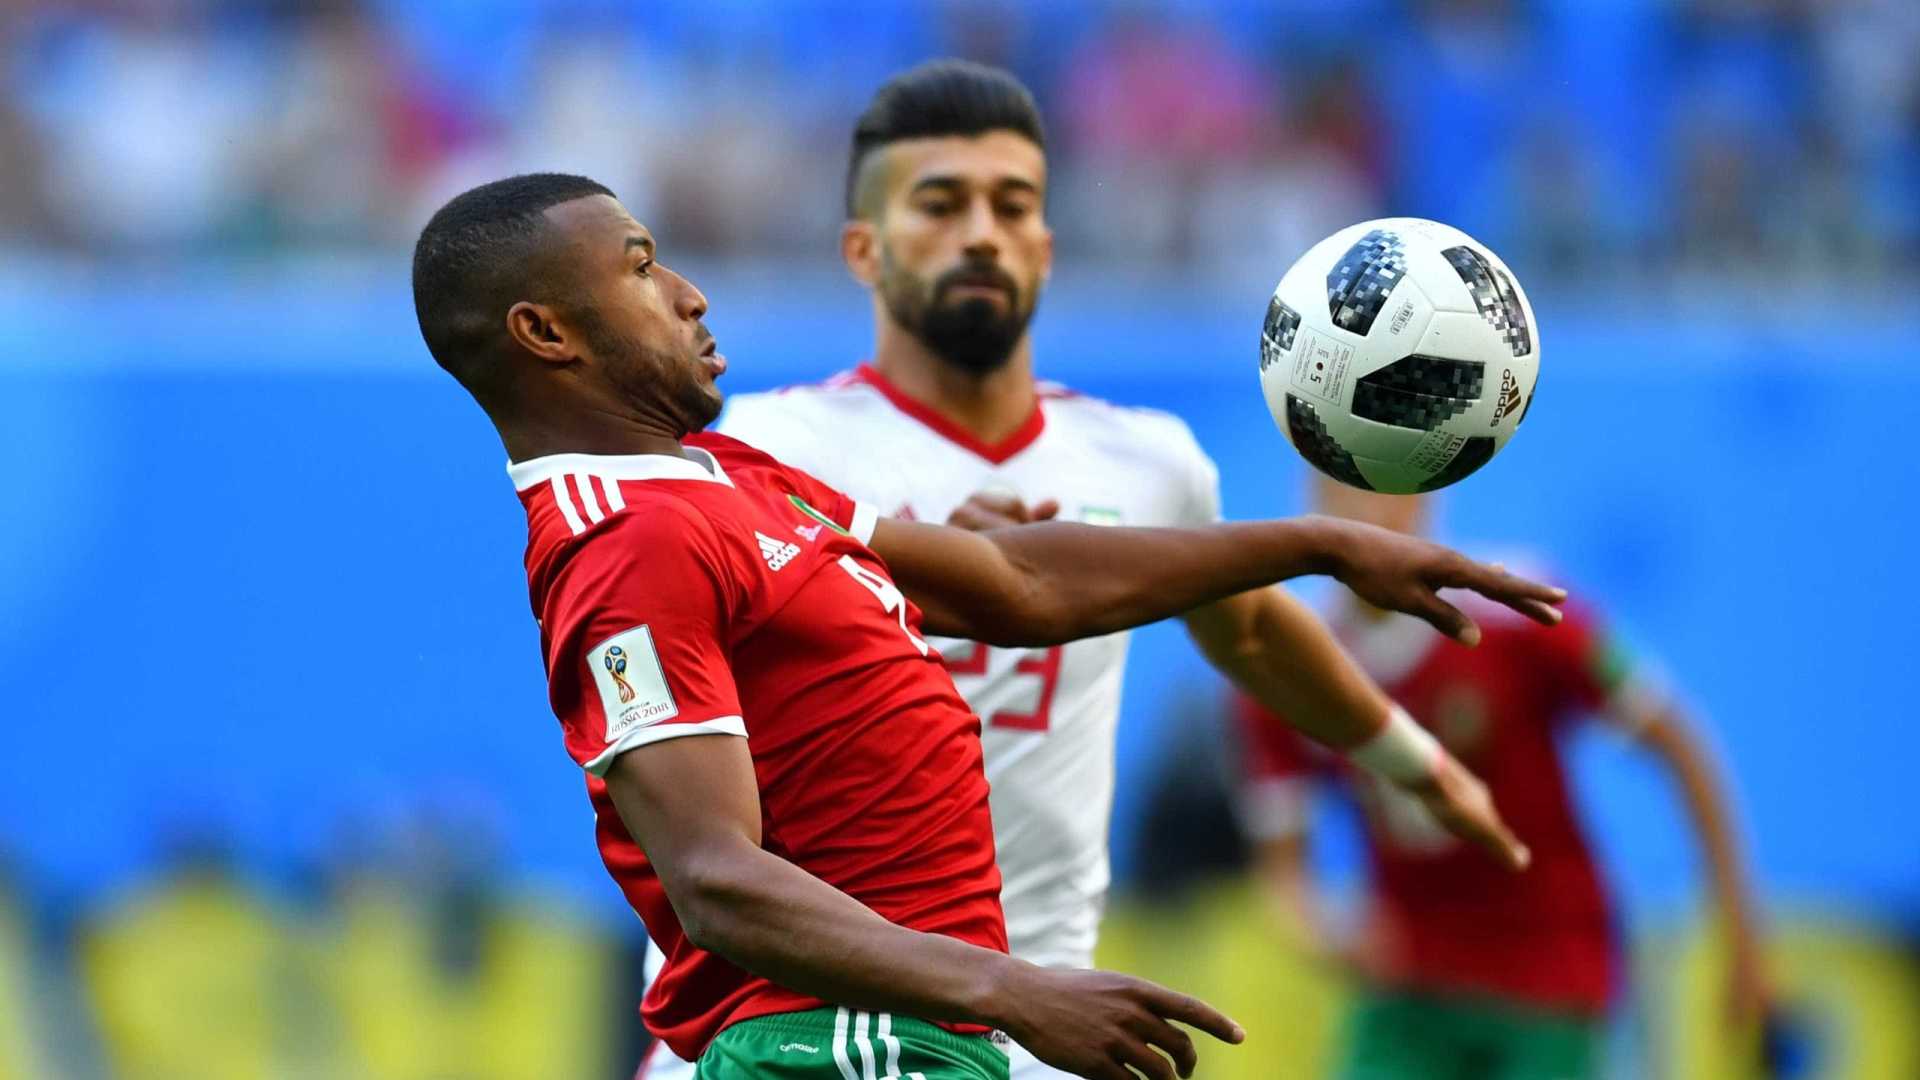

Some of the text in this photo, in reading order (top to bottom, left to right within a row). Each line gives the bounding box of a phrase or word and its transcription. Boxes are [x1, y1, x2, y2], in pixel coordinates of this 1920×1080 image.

[1310, 373, 1321, 384] 5
[1490, 368, 1510, 427] adidas
[768, 542, 801, 571] adidas
[642, 702, 669, 717] 2018
